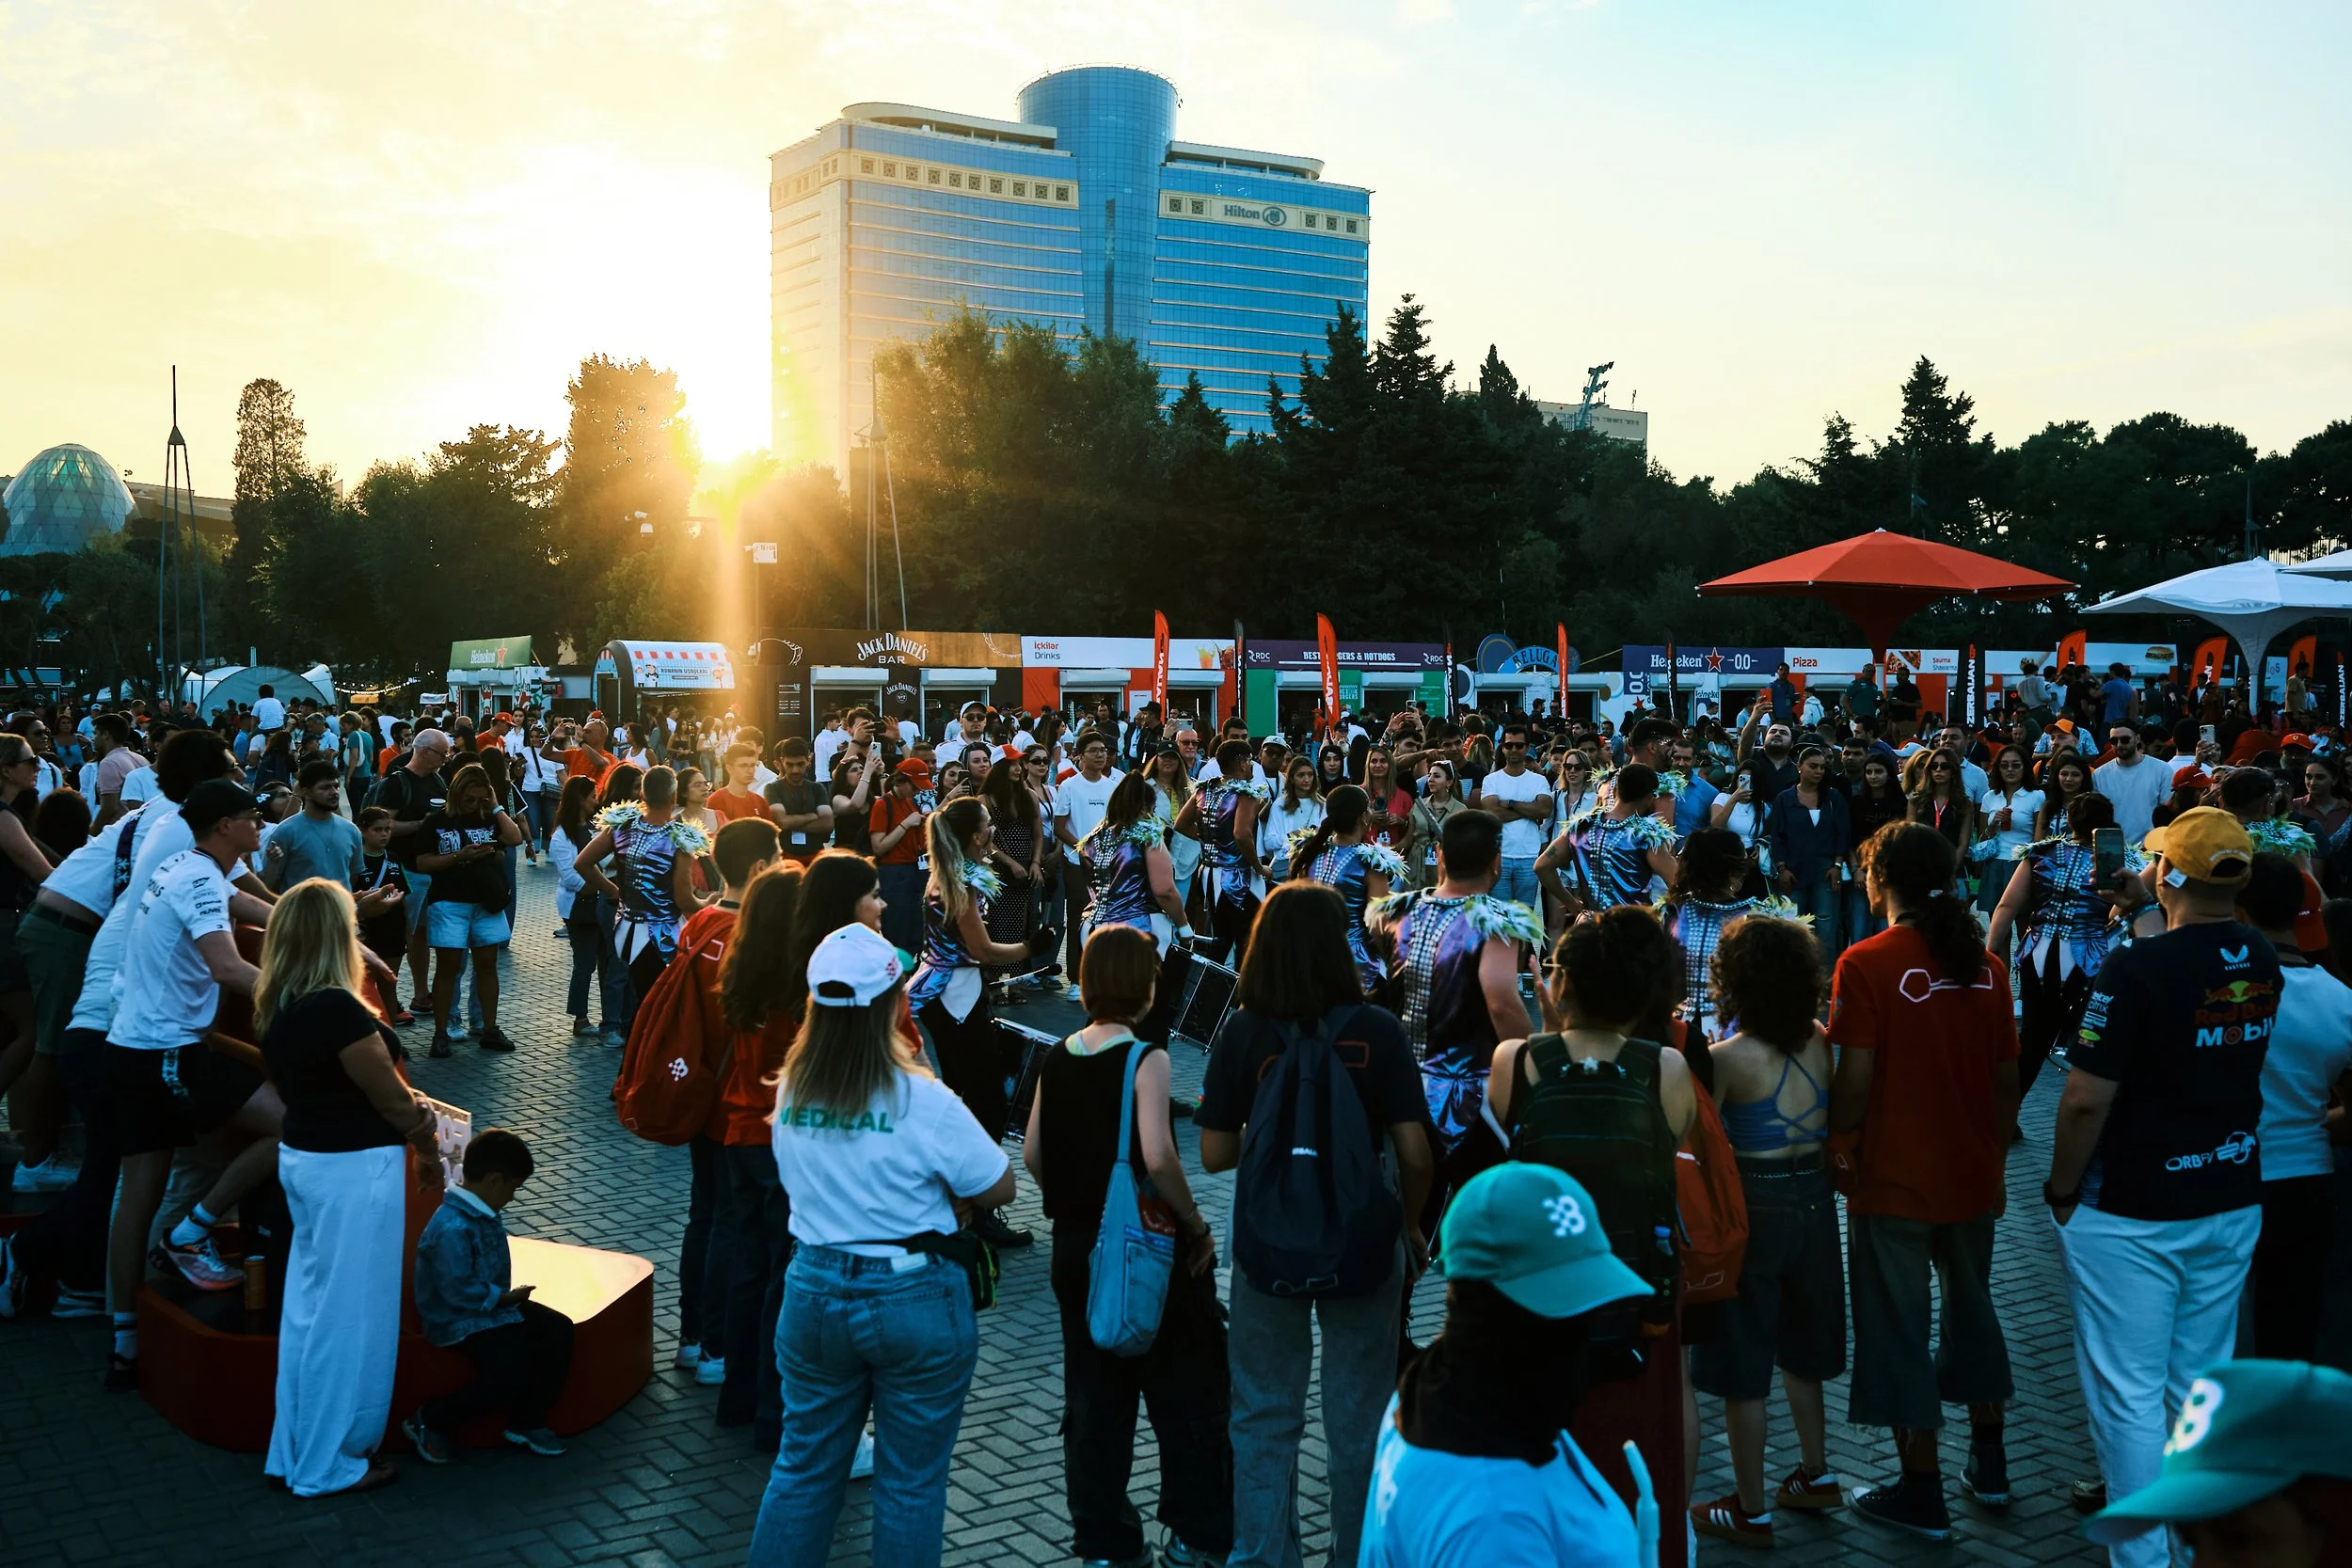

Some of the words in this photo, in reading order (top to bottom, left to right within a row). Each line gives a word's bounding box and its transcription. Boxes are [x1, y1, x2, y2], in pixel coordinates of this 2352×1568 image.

[1224, 204, 1261, 220] Hilton
[856, 637, 885, 661] JACK
[885, 632, 930, 662] DANIEL'S
[878, 655, 905, 664] BAR
[1035, 651, 1061, 660] Drinks
[1303, 651, 1321, 660] BEST
[1357, 652, 1363, 661] &
[1364, 652, 1396, 661] HOTDOGS
[1512, 648, 1559, 669] BELUGA
[1650, 654, 1703, 668] Heeken
[1792, 657, 1818, 668] Pizza
[780, 1105, 895, 1134] EDAL
